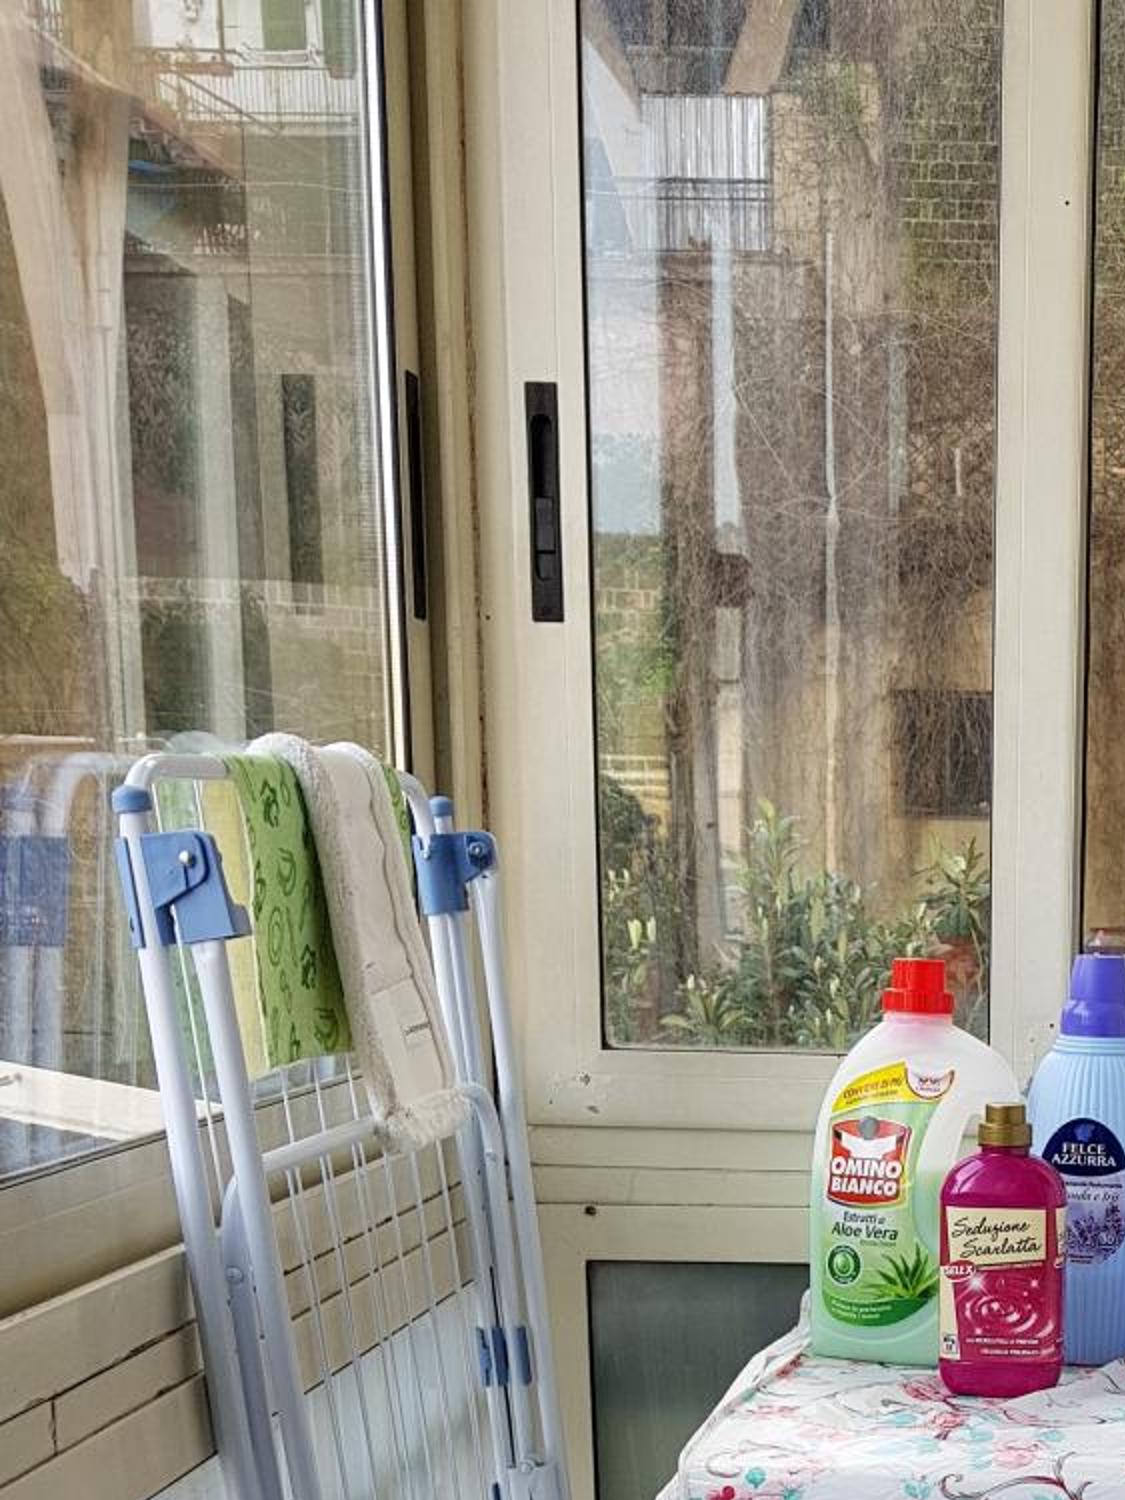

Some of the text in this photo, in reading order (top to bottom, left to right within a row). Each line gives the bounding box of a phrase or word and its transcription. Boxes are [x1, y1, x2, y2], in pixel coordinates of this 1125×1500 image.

[1062, 1142, 1106, 1155] FELCE
[831, 1155, 903, 1180] OMINO
[1051, 1153, 1117, 1167] AZZURRA
[831, 1176, 898, 1198] BIANCO
[831, 1221, 899, 1241] Aloe Vera
[951, 1216, 1031, 1242] Seduzione
[960, 1236, 1042, 1258] Scarlatta
